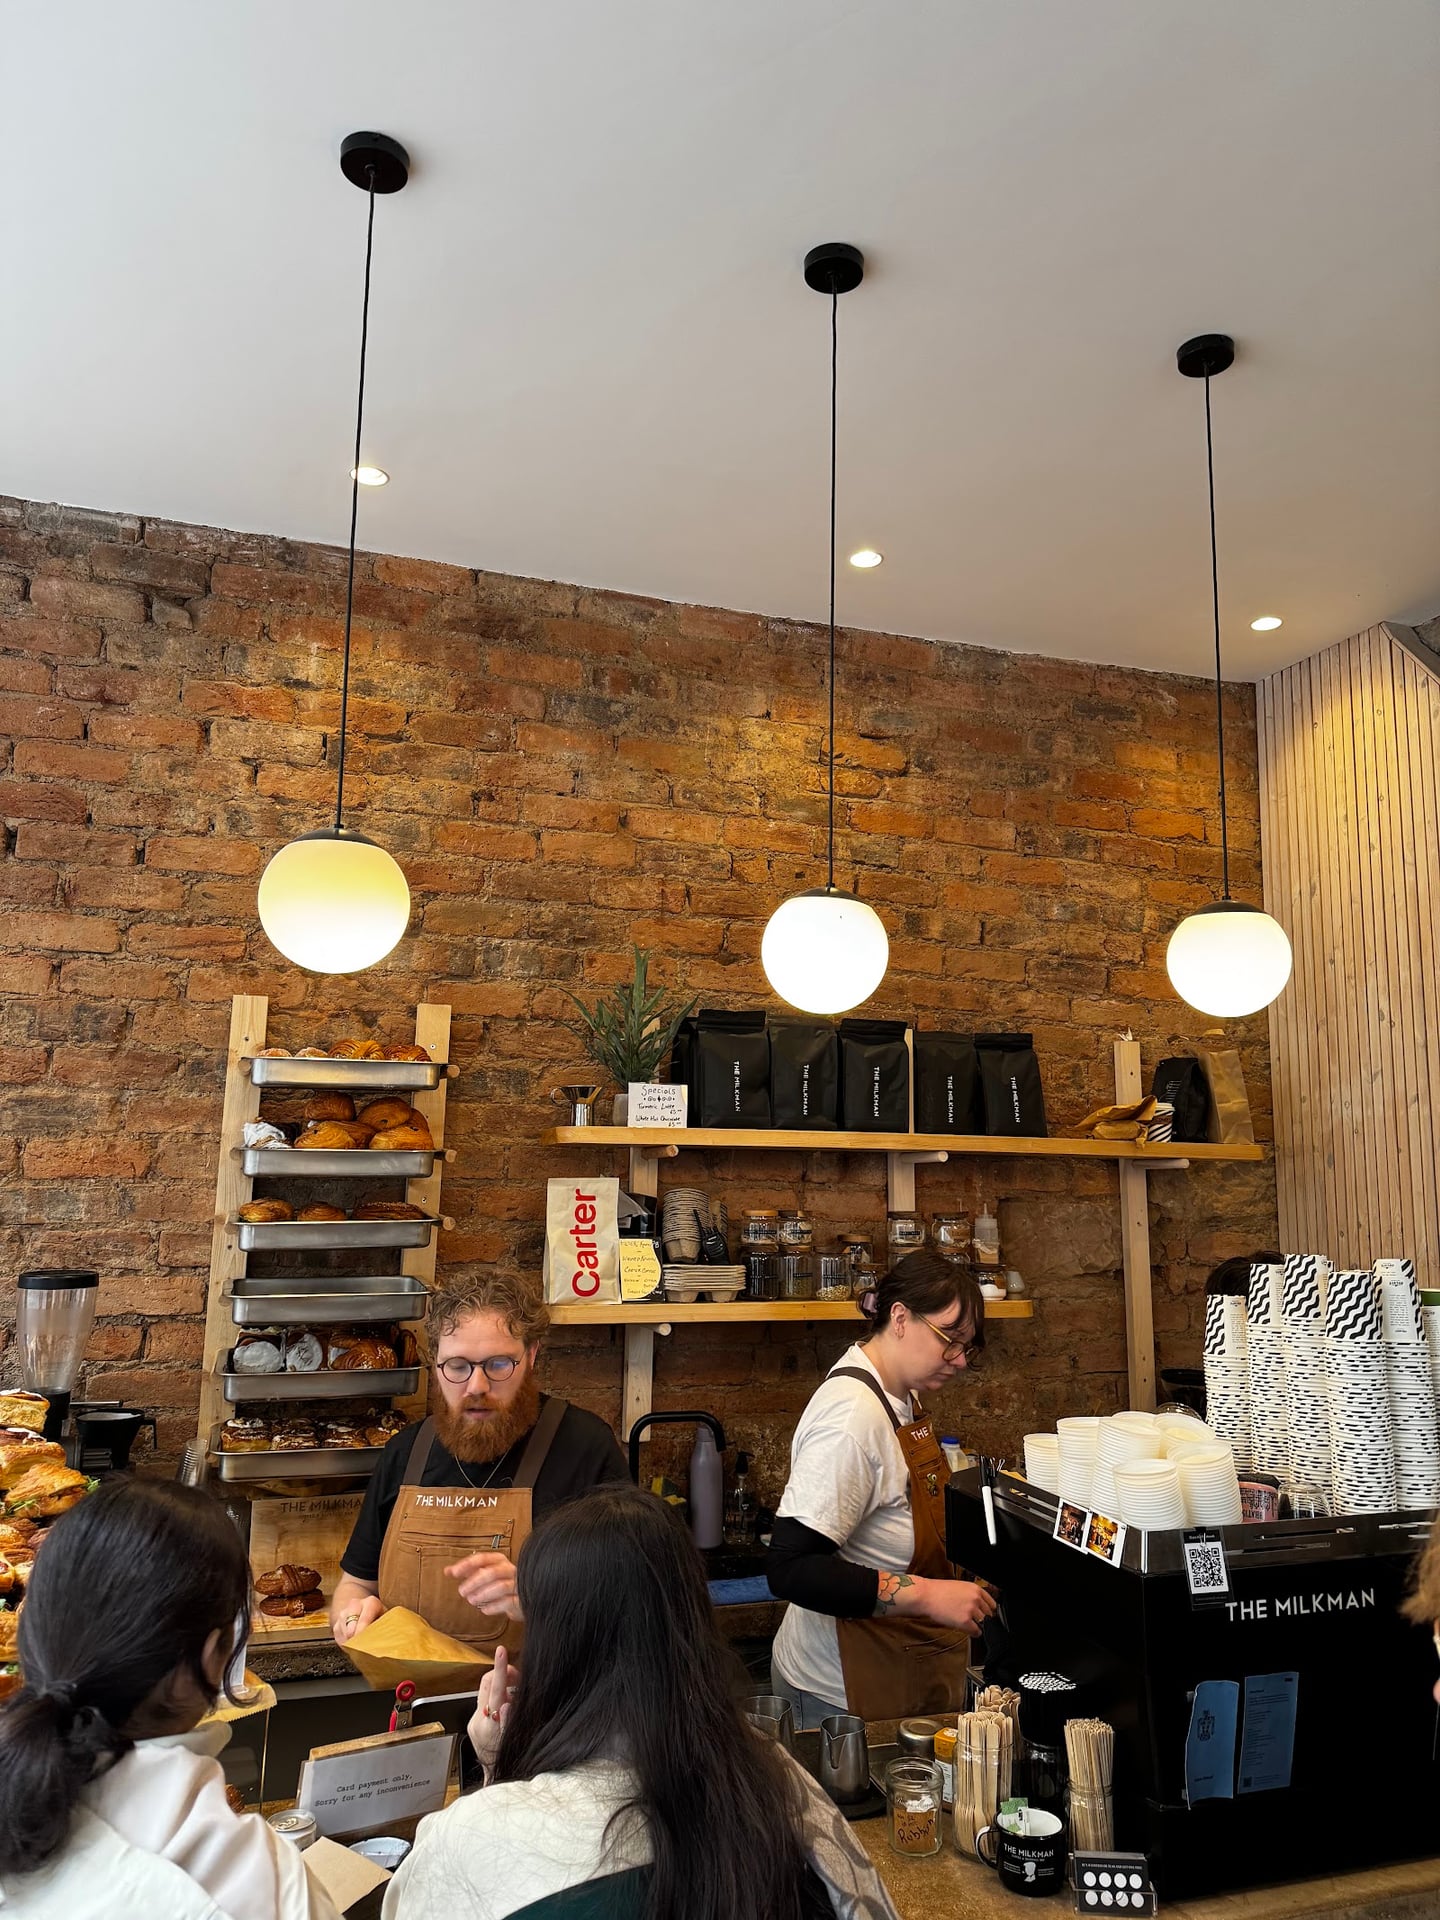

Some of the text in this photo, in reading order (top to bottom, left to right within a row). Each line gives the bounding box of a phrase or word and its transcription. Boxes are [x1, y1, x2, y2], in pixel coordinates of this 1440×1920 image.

[641, 1085, 676, 1096] Specials
[1010, 1076, 1021, 1123] THE MILKMAN
[569, 1188, 600, 1297] Carter
[910, 1426, 929, 1441] THE
[280, 1499, 361, 1513] THE MILKMA
[415, 1494, 498, 1507] THE MILKMAN
[1225, 1588, 1375, 1622] THE MILKMAN
[336, 1773, 413, 1793] Card payment only,
[315, 1779, 431, 1807] Sorry for any inconvenience
[1003, 1843, 1017, 1855] THE
[1018, 1848, 1054, 1858] MILKMAN
